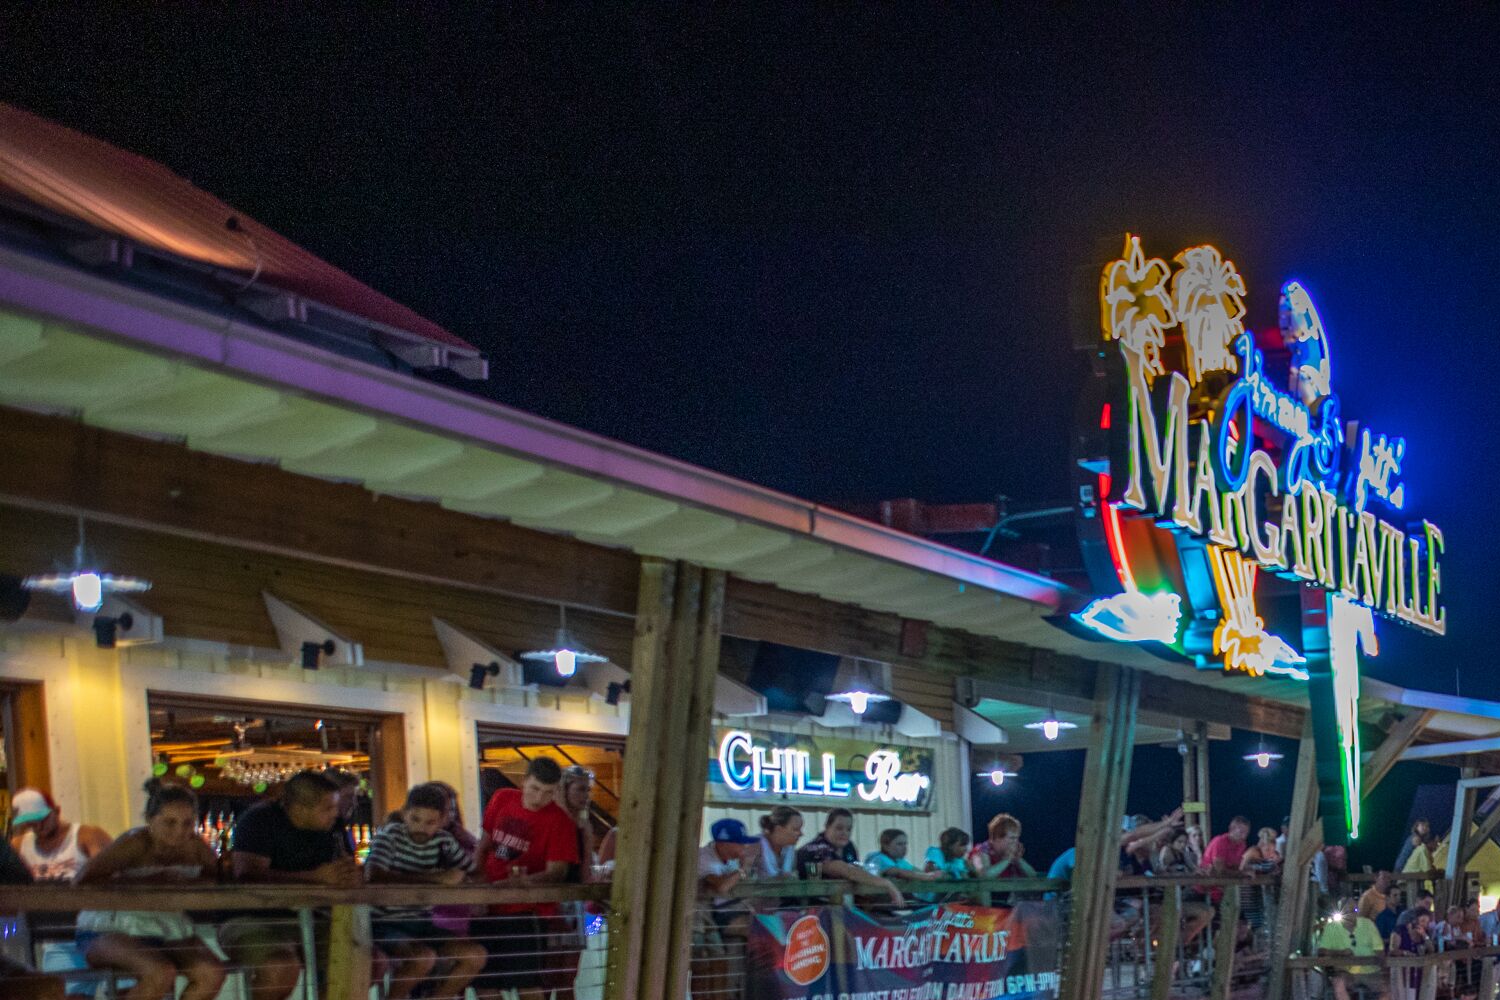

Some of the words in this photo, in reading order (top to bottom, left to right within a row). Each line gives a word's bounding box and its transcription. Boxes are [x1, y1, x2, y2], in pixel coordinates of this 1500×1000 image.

[1120, 338, 1446, 636] MARGARITAVILLE
[719, 730, 850, 797] CHILL
[857, 749, 930, 803] Bar
